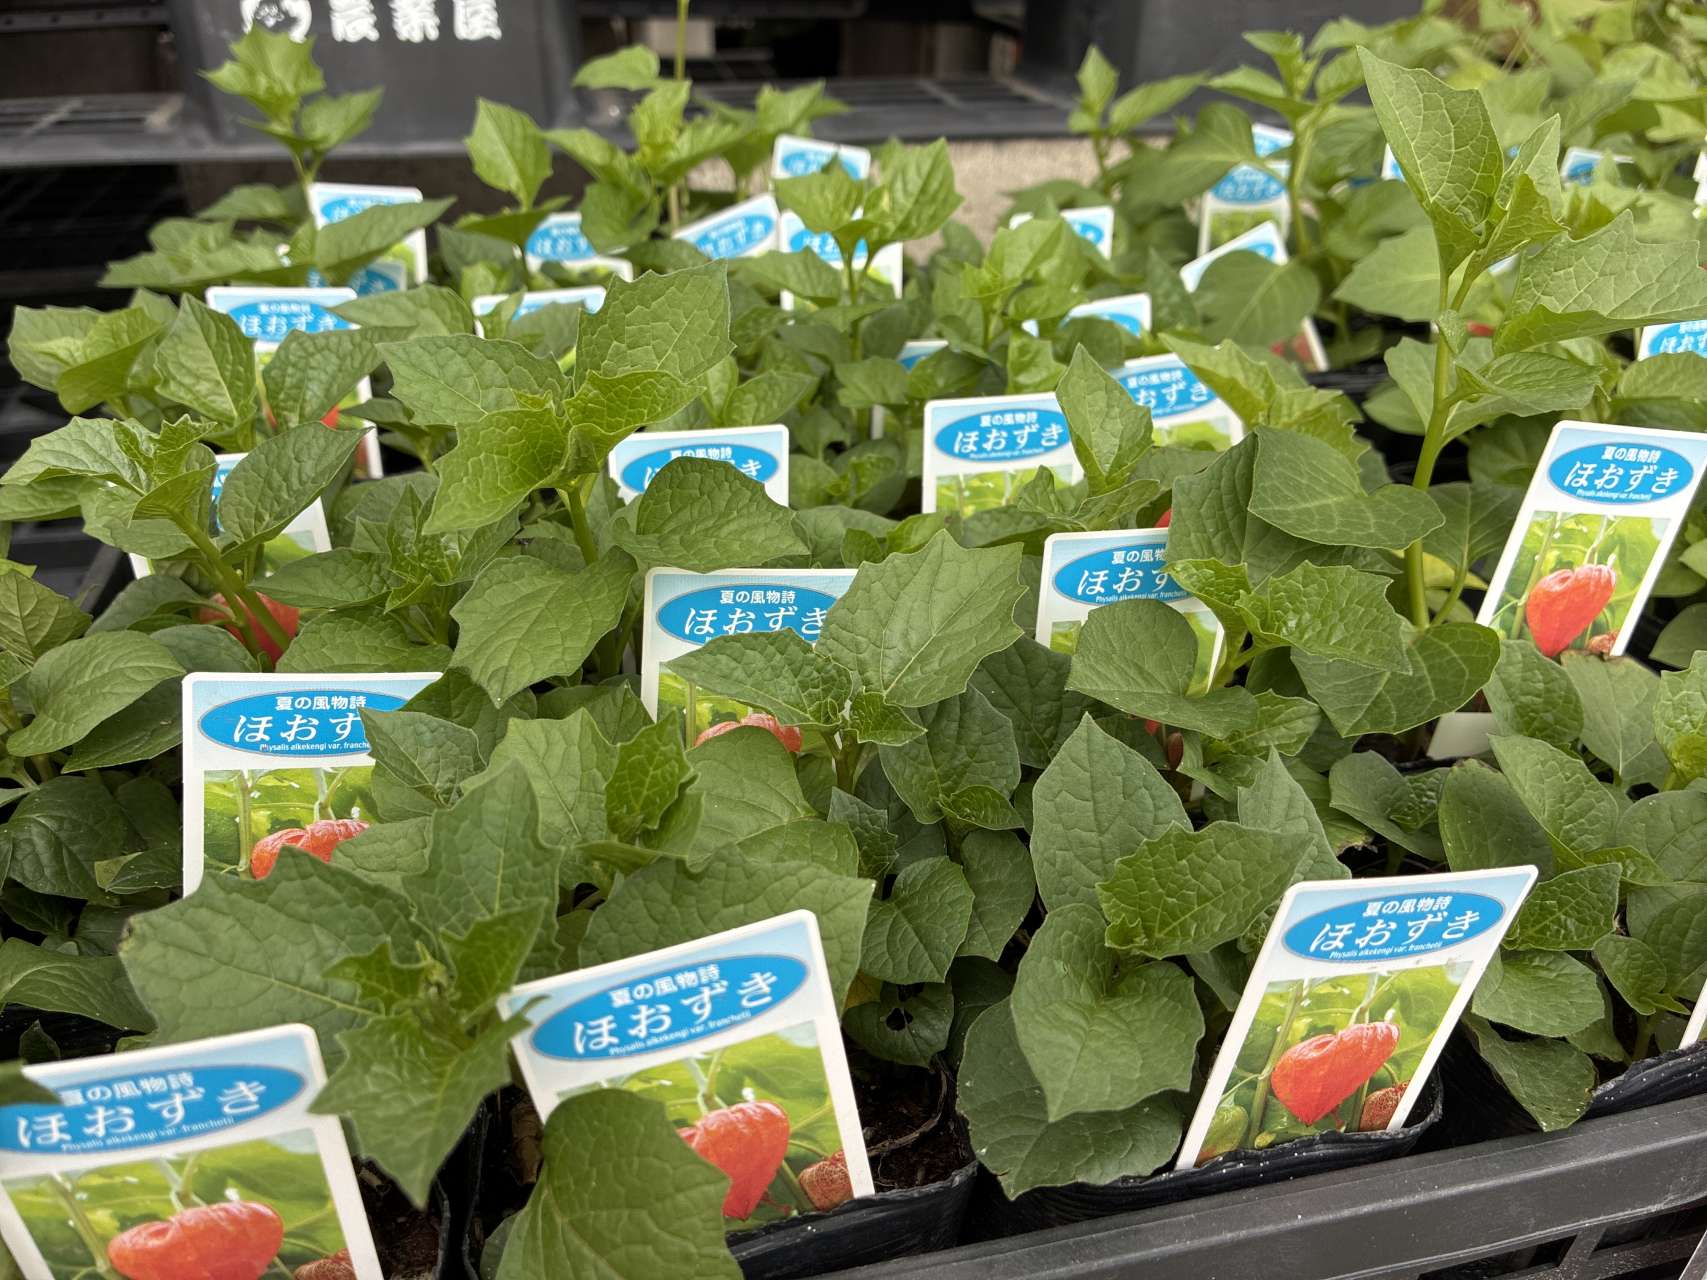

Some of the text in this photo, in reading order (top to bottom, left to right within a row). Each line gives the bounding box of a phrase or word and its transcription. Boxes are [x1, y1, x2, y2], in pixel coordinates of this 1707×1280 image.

[952, 421, 1065, 454] ほおずき
[1601, 445, 1663, 463] 夏の風物詩
[1563, 460, 1680, 494] ほおずき
[719, 589, 796, 604] 夏の風物詩
[683, 605, 828, 636] ほおずき
[274, 695, 368, 711] 夏の風物詩
[290, 742, 327, 751] alkekengi
[1361, 895, 1453, 917] 夏の風物詩
[1309, 910, 1480, 953] ほおずき
[609, 963, 721, 1009] 夏の風物詩
[572, 971, 779, 1055] ほおずき
[59, 1071, 195, 1106] 夏の風物詩
[17, 1080, 267, 1148] ほおずき
